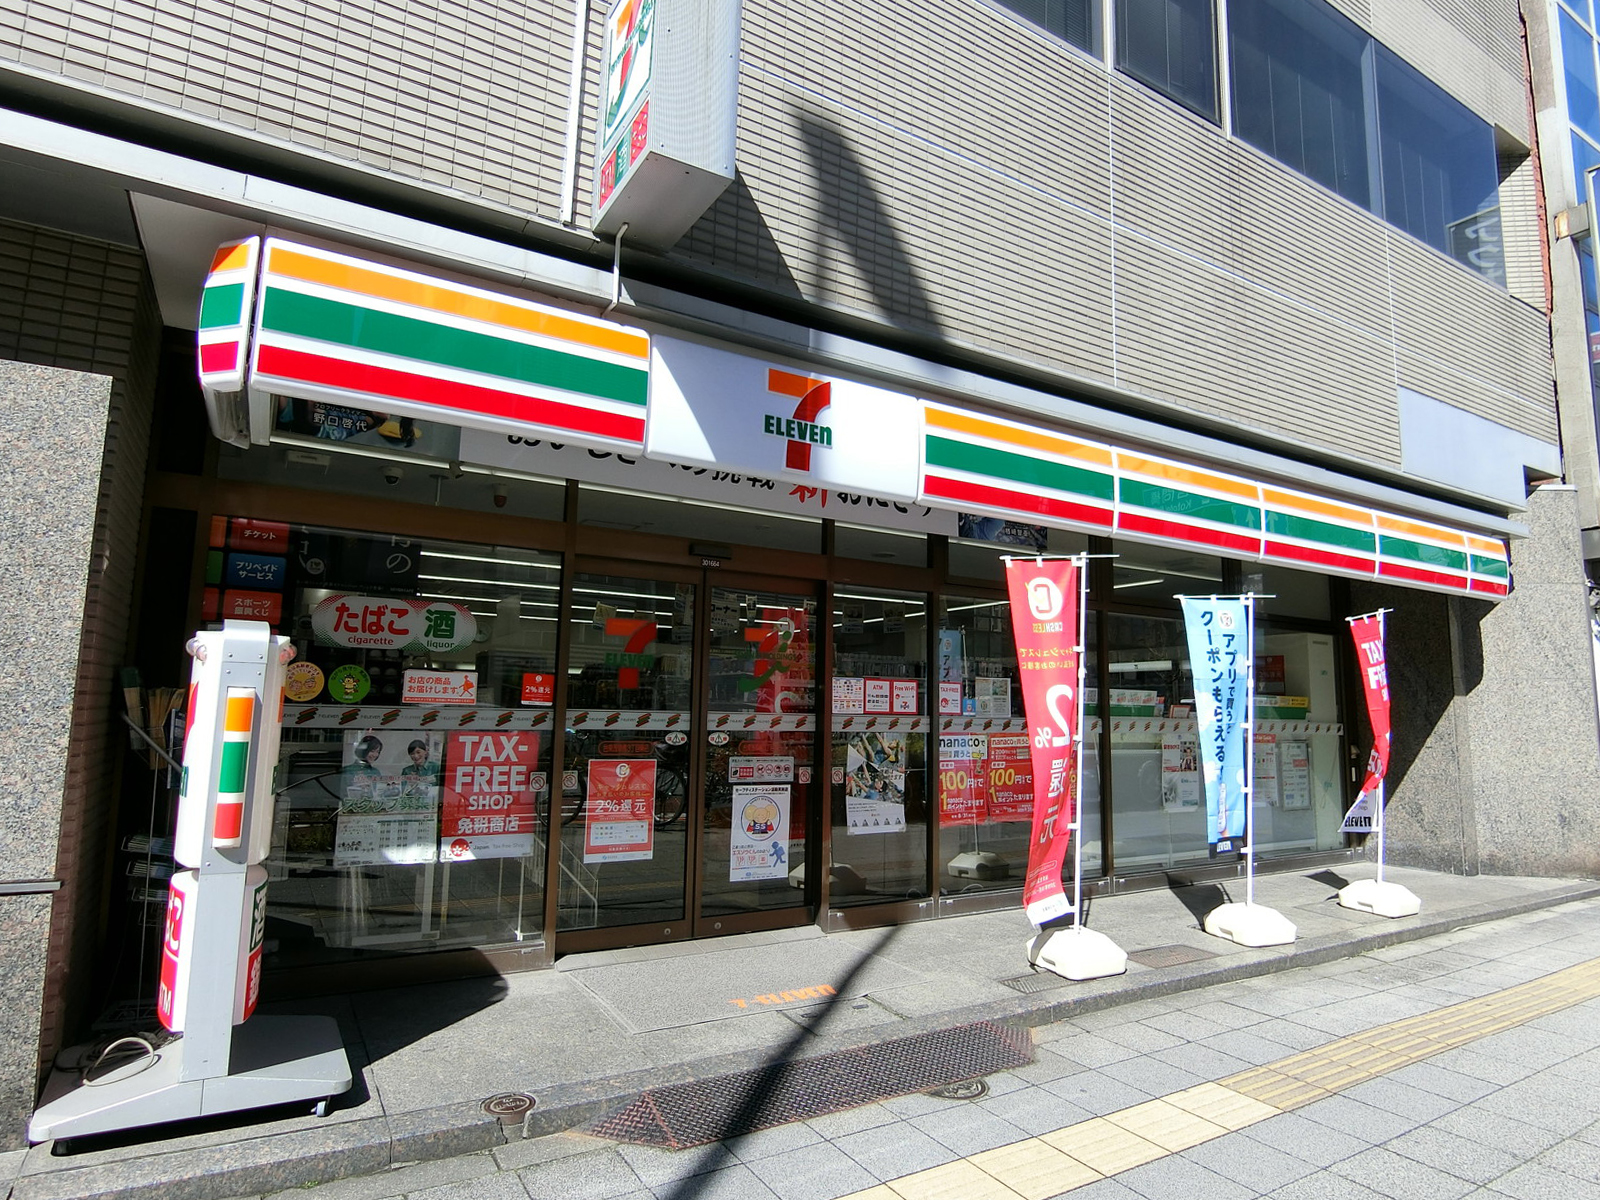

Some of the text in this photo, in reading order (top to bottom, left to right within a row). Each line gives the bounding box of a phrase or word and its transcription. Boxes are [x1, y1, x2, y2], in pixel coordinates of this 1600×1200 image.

[313, 412, 368, 432] 野口啓代
[767, 367, 832, 472] 7
[244, 529, 276, 540] チケット
[236, 561, 278, 571] プリペイド
[238, 570, 273, 580] サービス
[234, 598, 271, 608] スポーツ
[333, 601, 410, 635] たばこ
[424, 608, 457, 639] 酒
[347, 635, 394, 647] cigarette
[426, 639, 455, 650] liquor
[604, 618, 658, 690] 7
[408, 675, 452, 686] お店の商品
[407, 684, 460, 695] お届けします。
[525, 685, 552, 695] 2%還元
[459, 735, 528, 762] TAX-
[455, 765, 527, 793] FREE
[989, 769, 1022, 785] 100円
[468, 794, 514, 810] SHOP
[941, 791, 948, 810] 1
[989, 786, 998, 803] 1
[595, 799, 646, 813] 2%還元
[963, 799, 984, 807] たまります
[458, 816, 520, 834] 免税商店
